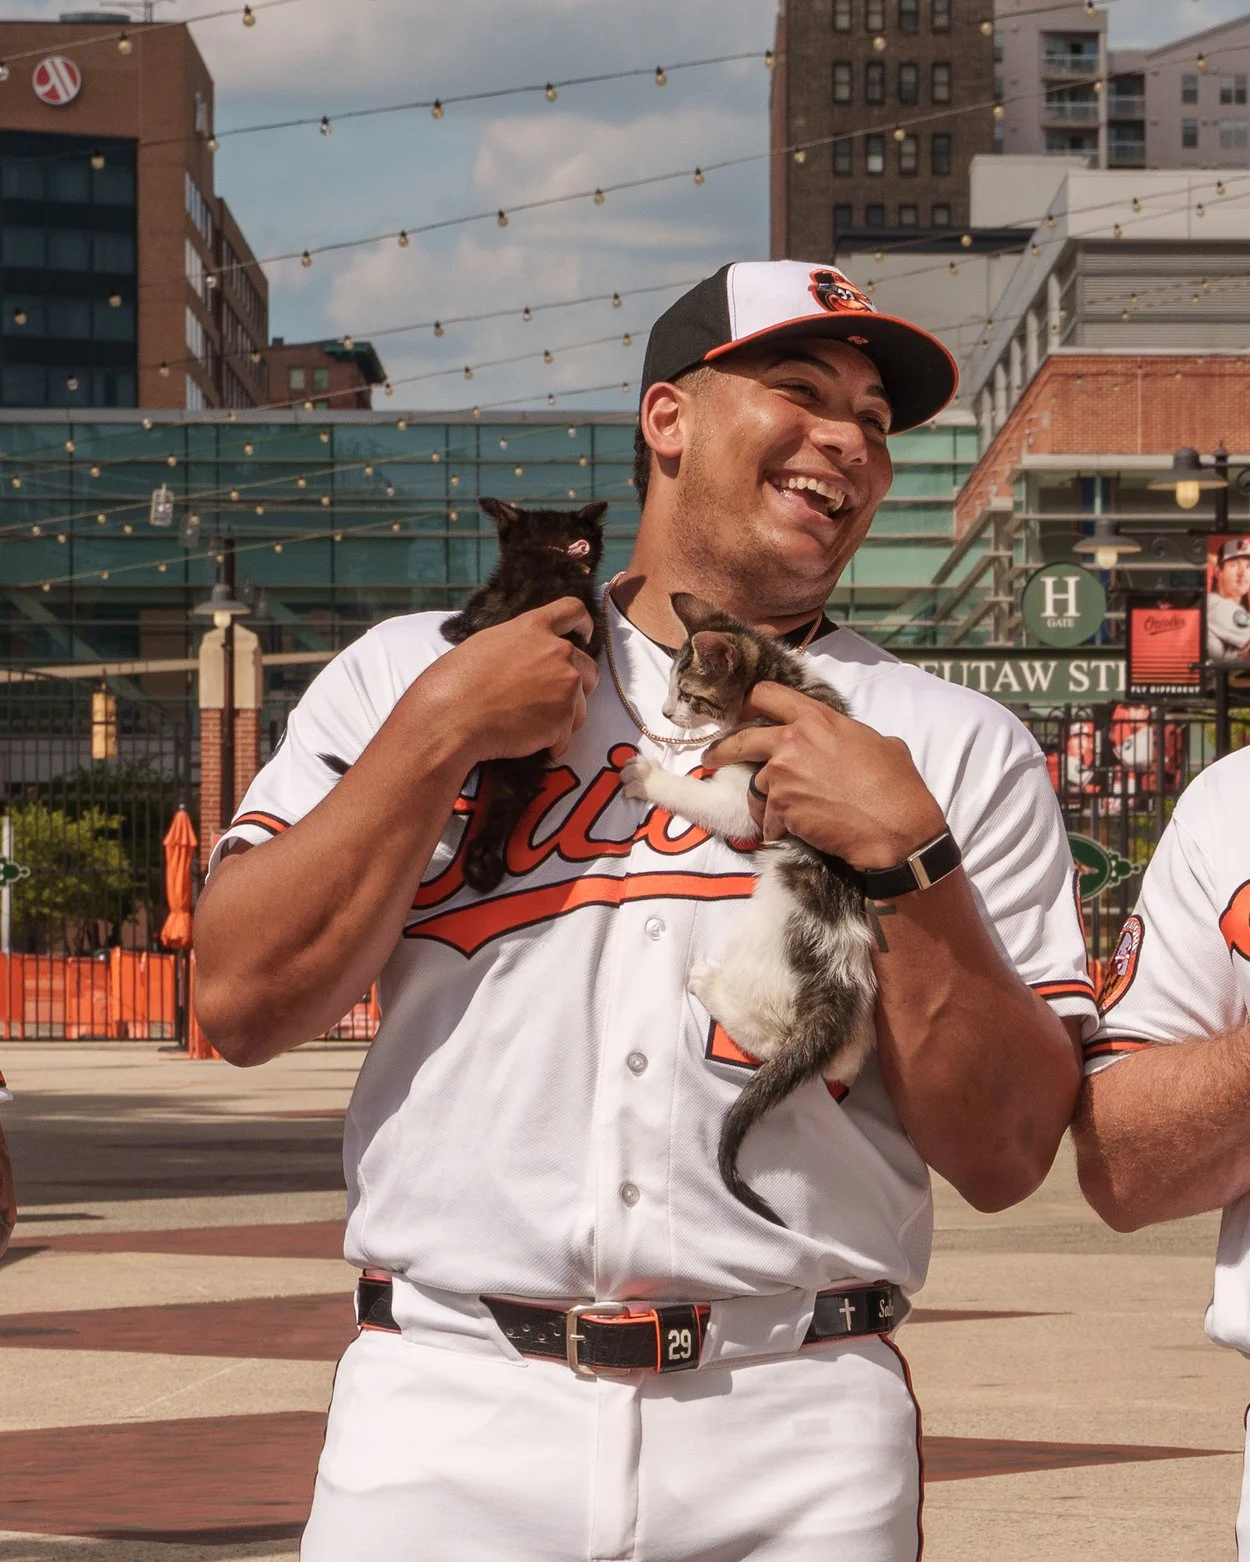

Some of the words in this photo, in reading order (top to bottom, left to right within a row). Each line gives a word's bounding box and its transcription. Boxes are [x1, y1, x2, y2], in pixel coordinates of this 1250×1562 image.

[1040, 576, 1081, 617] H
[1047, 618, 1076, 628] GATE
[668, 1329, 692, 1360] 29
